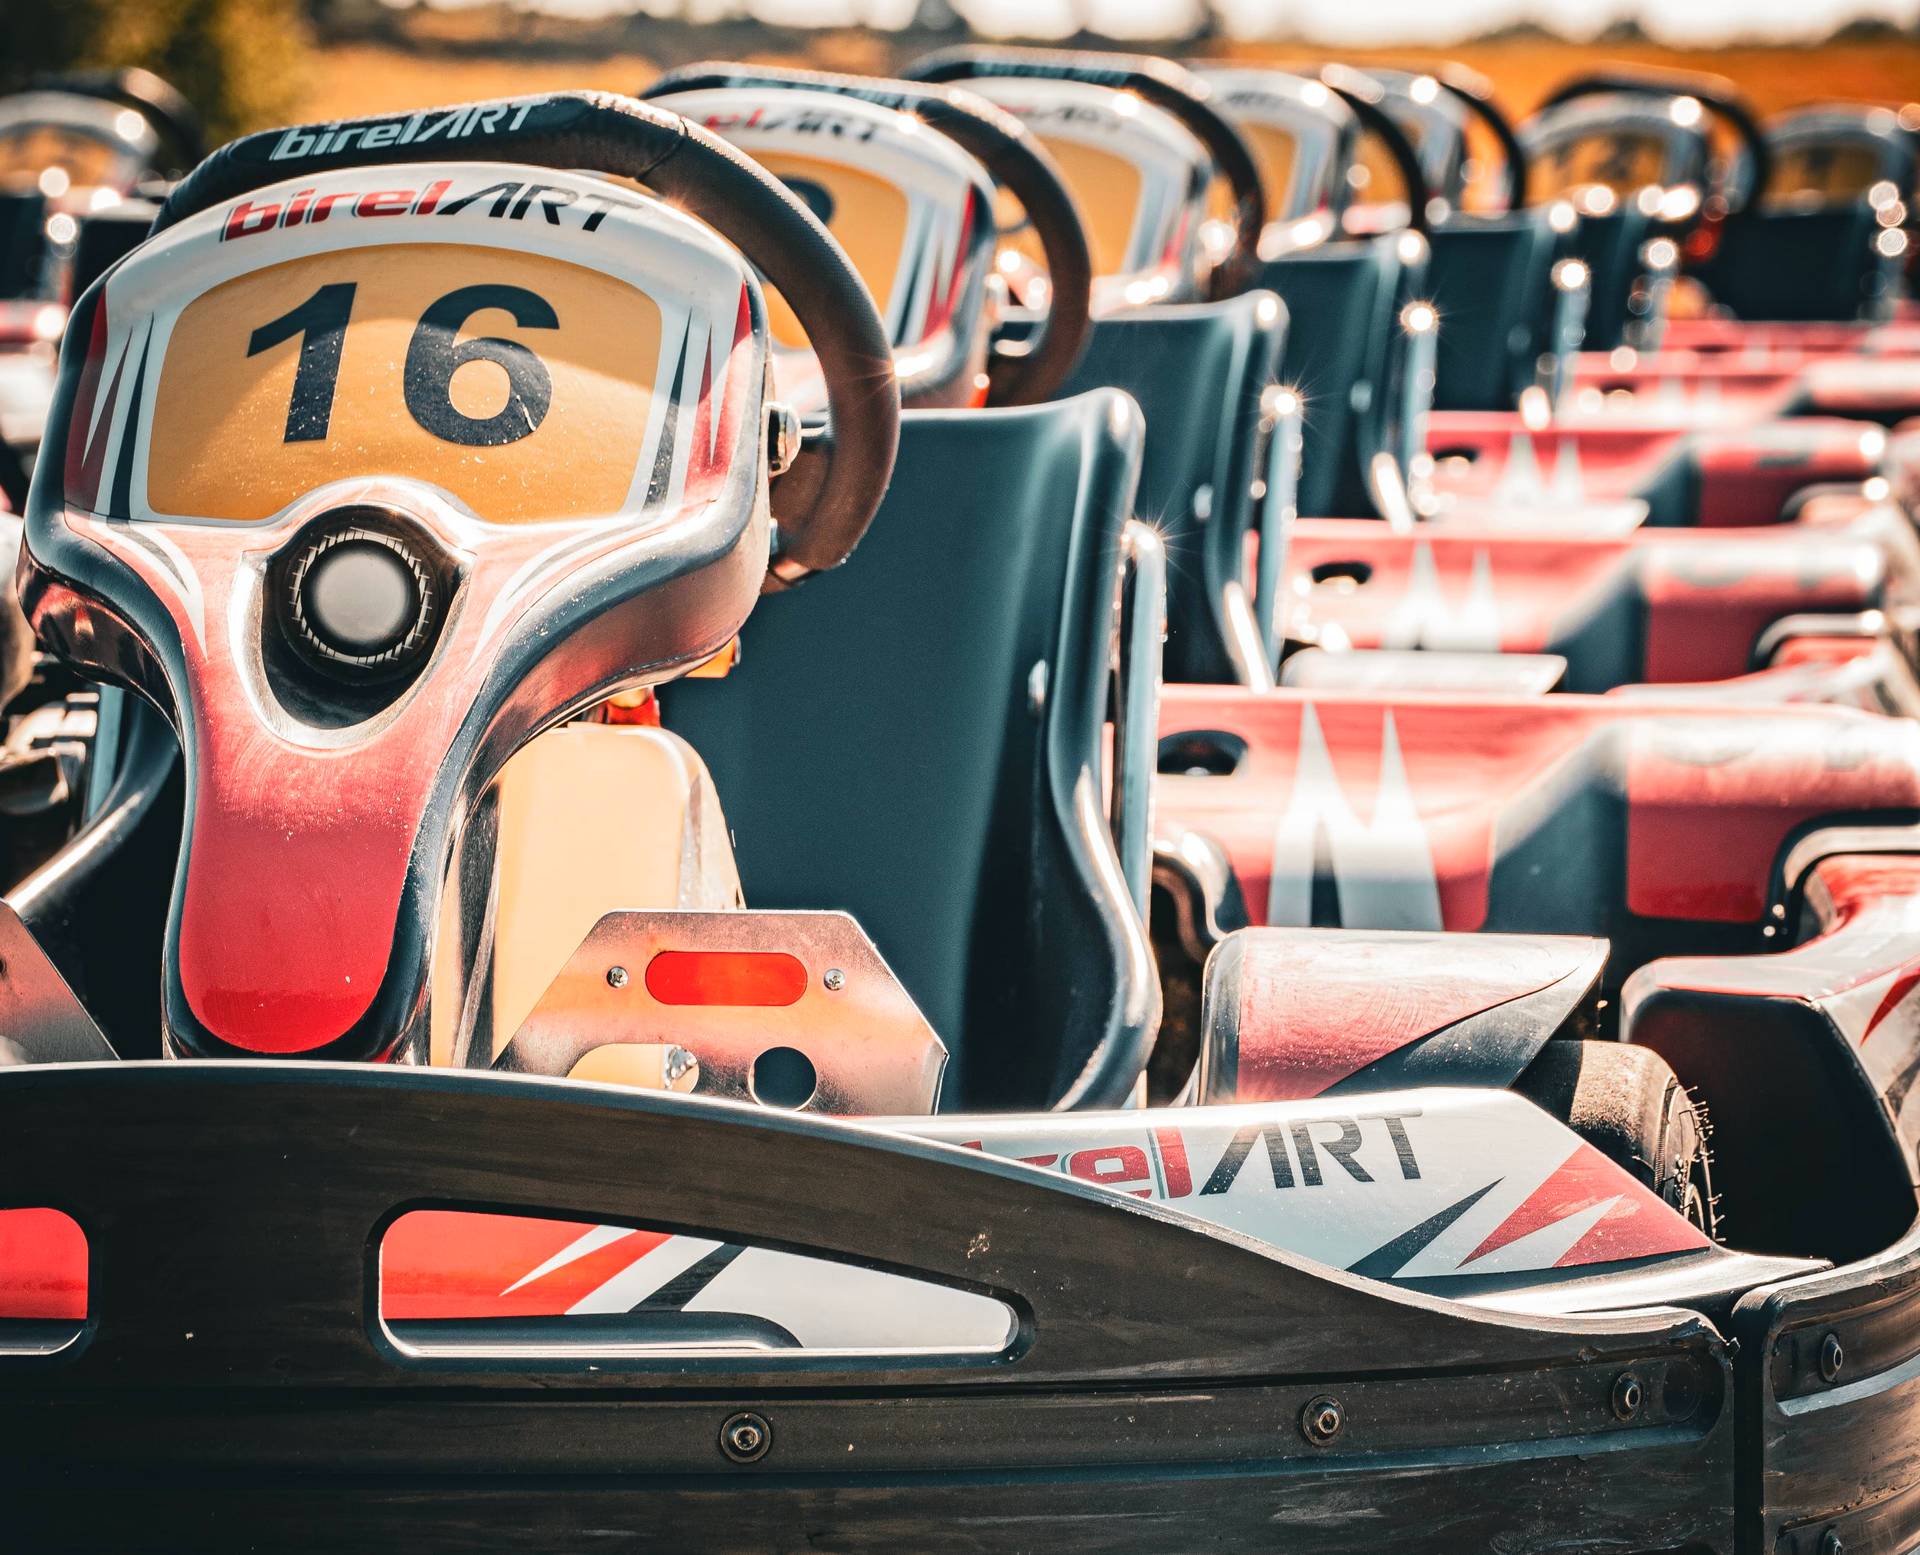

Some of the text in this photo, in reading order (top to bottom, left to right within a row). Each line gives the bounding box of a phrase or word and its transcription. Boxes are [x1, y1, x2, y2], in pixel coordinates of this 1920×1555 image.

[268, 98, 551, 162] birelART
[219, 180, 642, 243] birelART
[247, 282, 560, 448] 16
